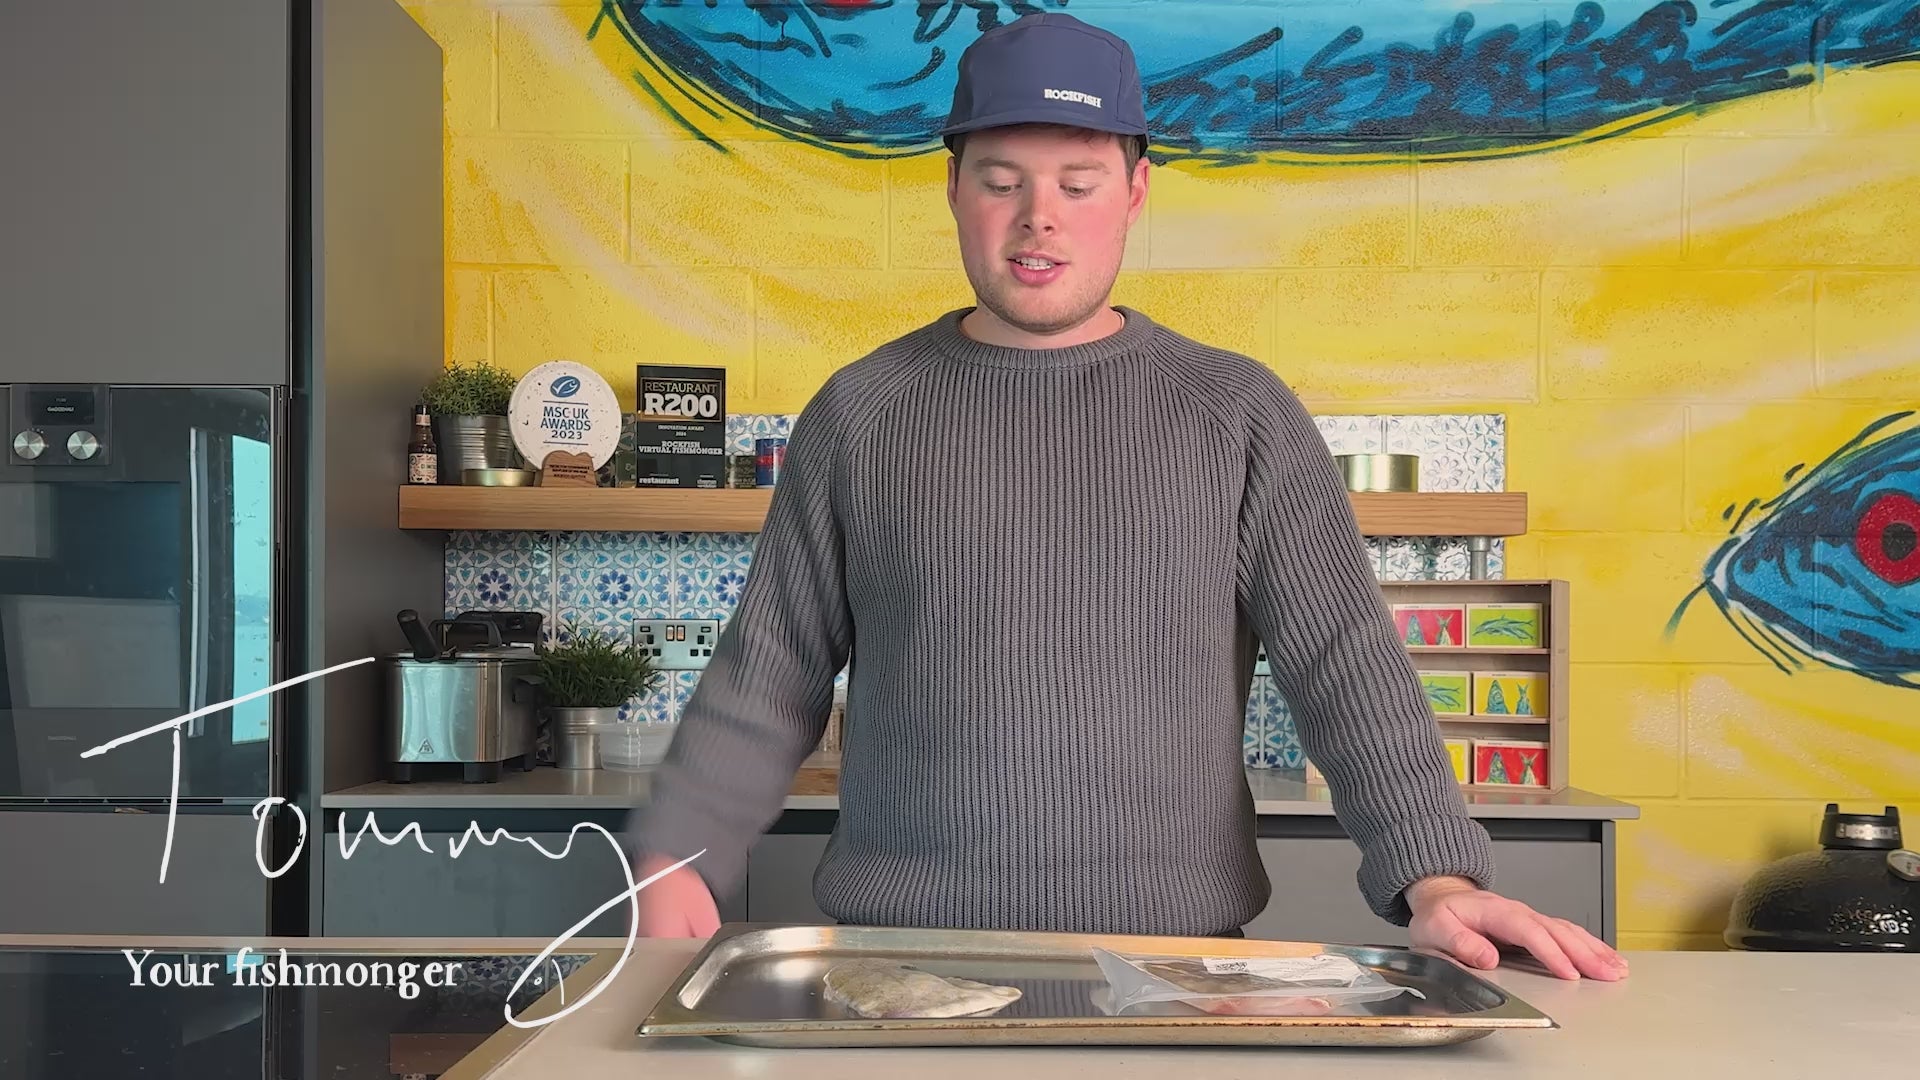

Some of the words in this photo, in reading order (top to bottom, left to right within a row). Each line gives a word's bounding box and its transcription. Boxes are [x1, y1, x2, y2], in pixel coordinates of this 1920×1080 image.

[1044, 89, 1102, 108] ROCKFISH
[645, 382, 718, 394] RESTAURANT
[644, 393, 718, 418] R200
[543, 406, 570, 419] MSC
[572, 407, 589, 420] UK
[540, 417, 592, 431] AWARDS
[551, 430, 582, 440] 2023
[638, 446, 671, 454] VIRTUAL
[672, 447, 723, 455] FISHMONGER
[639, 477, 680, 485] restaurant
